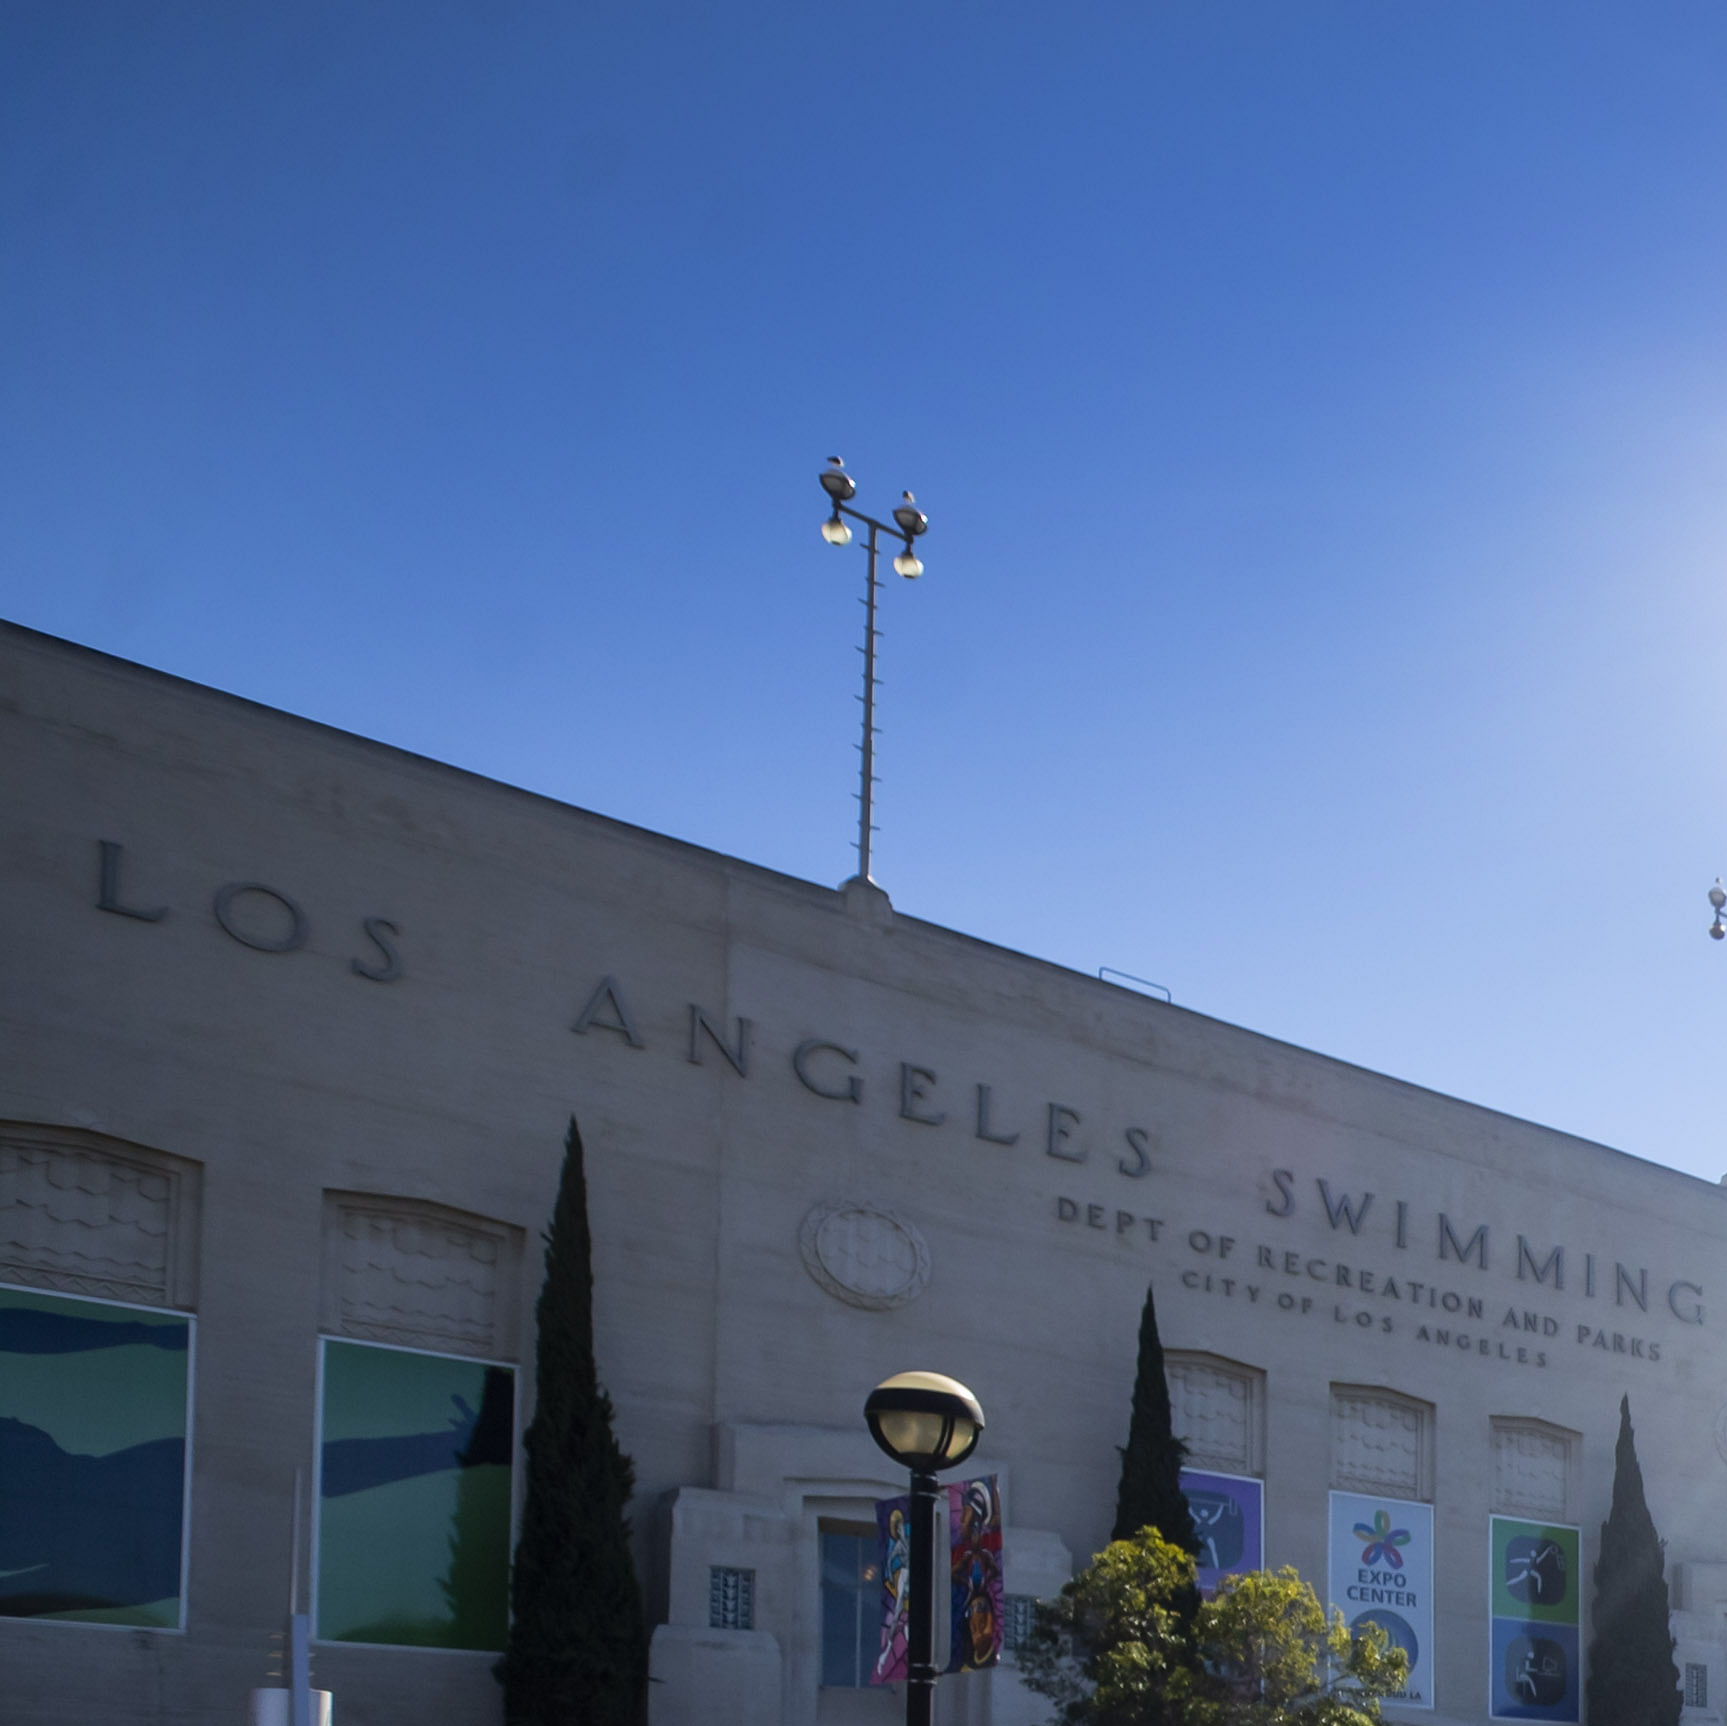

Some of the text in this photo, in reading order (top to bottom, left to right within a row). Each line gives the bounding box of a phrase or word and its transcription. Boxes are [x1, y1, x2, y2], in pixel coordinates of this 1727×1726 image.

[96, 840, 402, 983] LOS
[571, 975, 1152, 1178] ANGELES
[1266, 1169, 1704, 1326] SWIMMING
[1057, 1196, 1661, 1361] DEPT OF RECREATION AND PARKS
[1182, 1271, 1547, 1367] CITY OF LOS ANGELES
[1346, 1585, 1417, 1608] CENTER
[1358, 1569, 1406, 1588] EXPO
